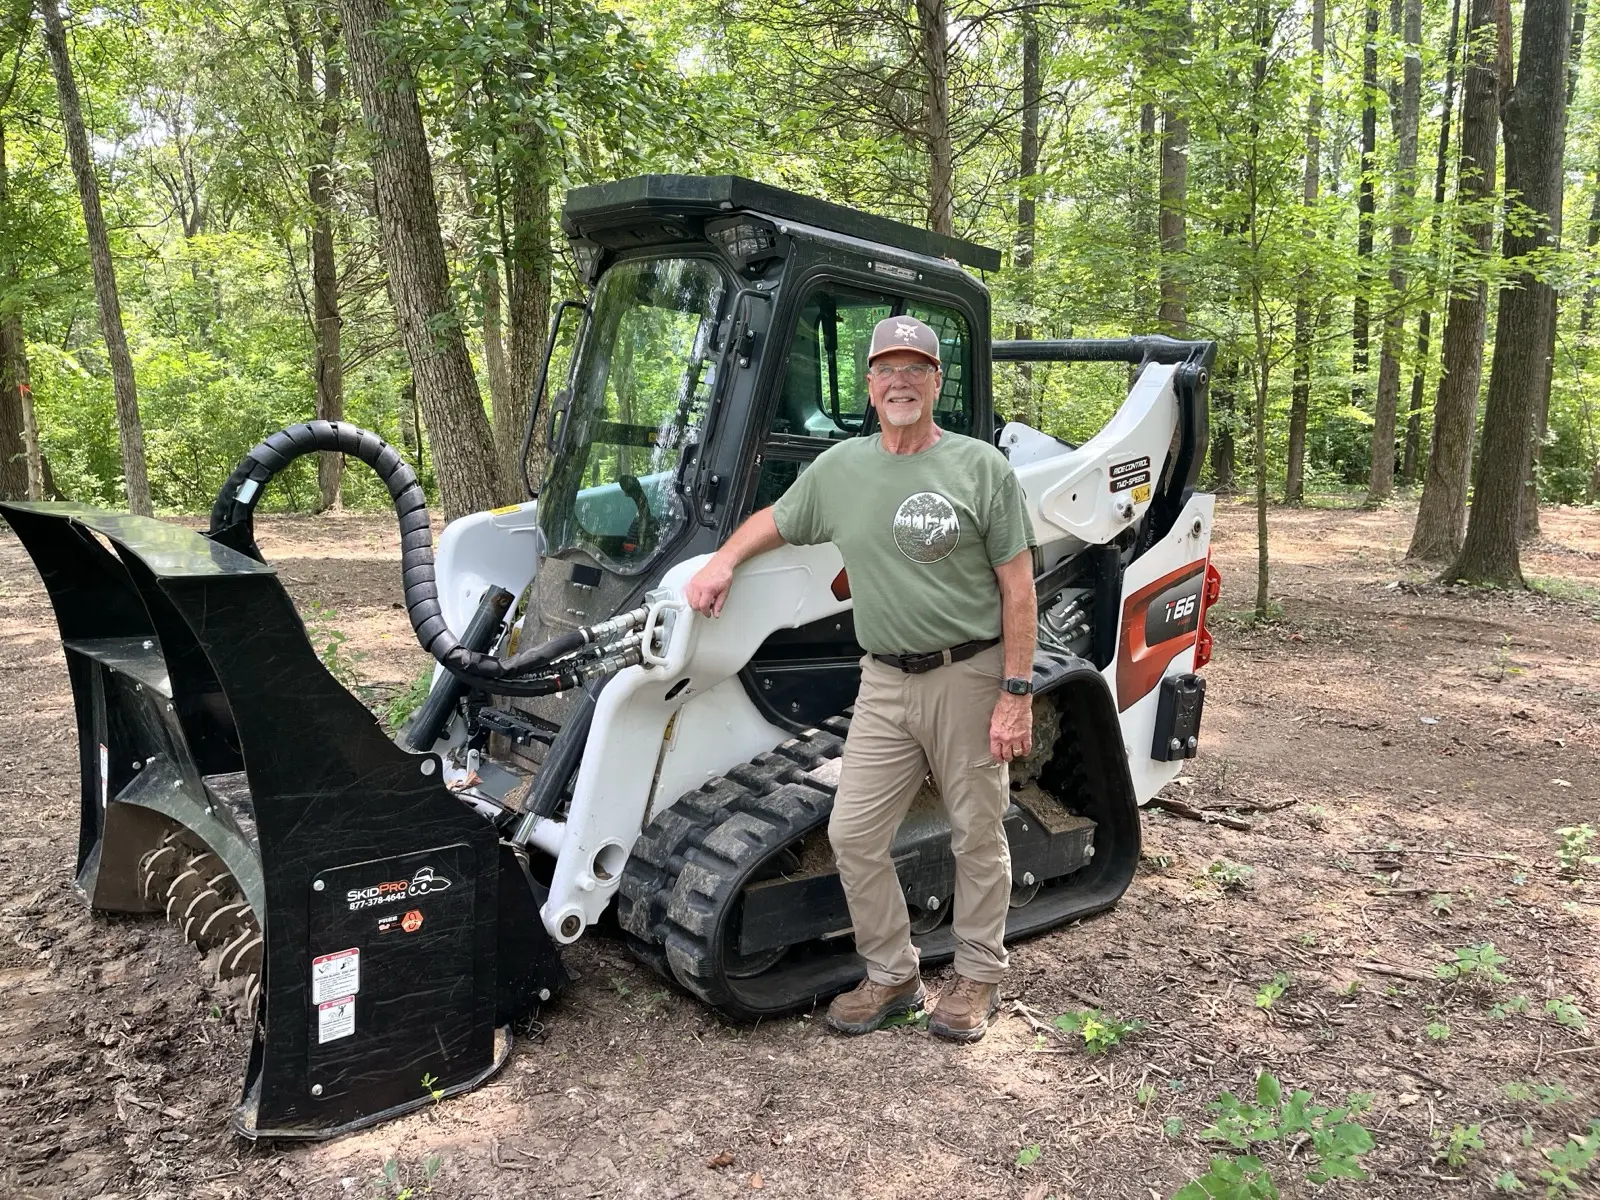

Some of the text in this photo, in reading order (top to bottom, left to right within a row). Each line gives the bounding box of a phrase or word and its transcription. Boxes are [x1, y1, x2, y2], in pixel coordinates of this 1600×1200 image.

[1113, 459, 1148, 475] RIDE CONTROL
[1116, 474, 1146, 489] TWO-SPEED
[1165, 594, 1197, 623] T66
[347, 881, 408, 901] SKIDPRO
[349, 892, 406, 910] 877-378-4642
